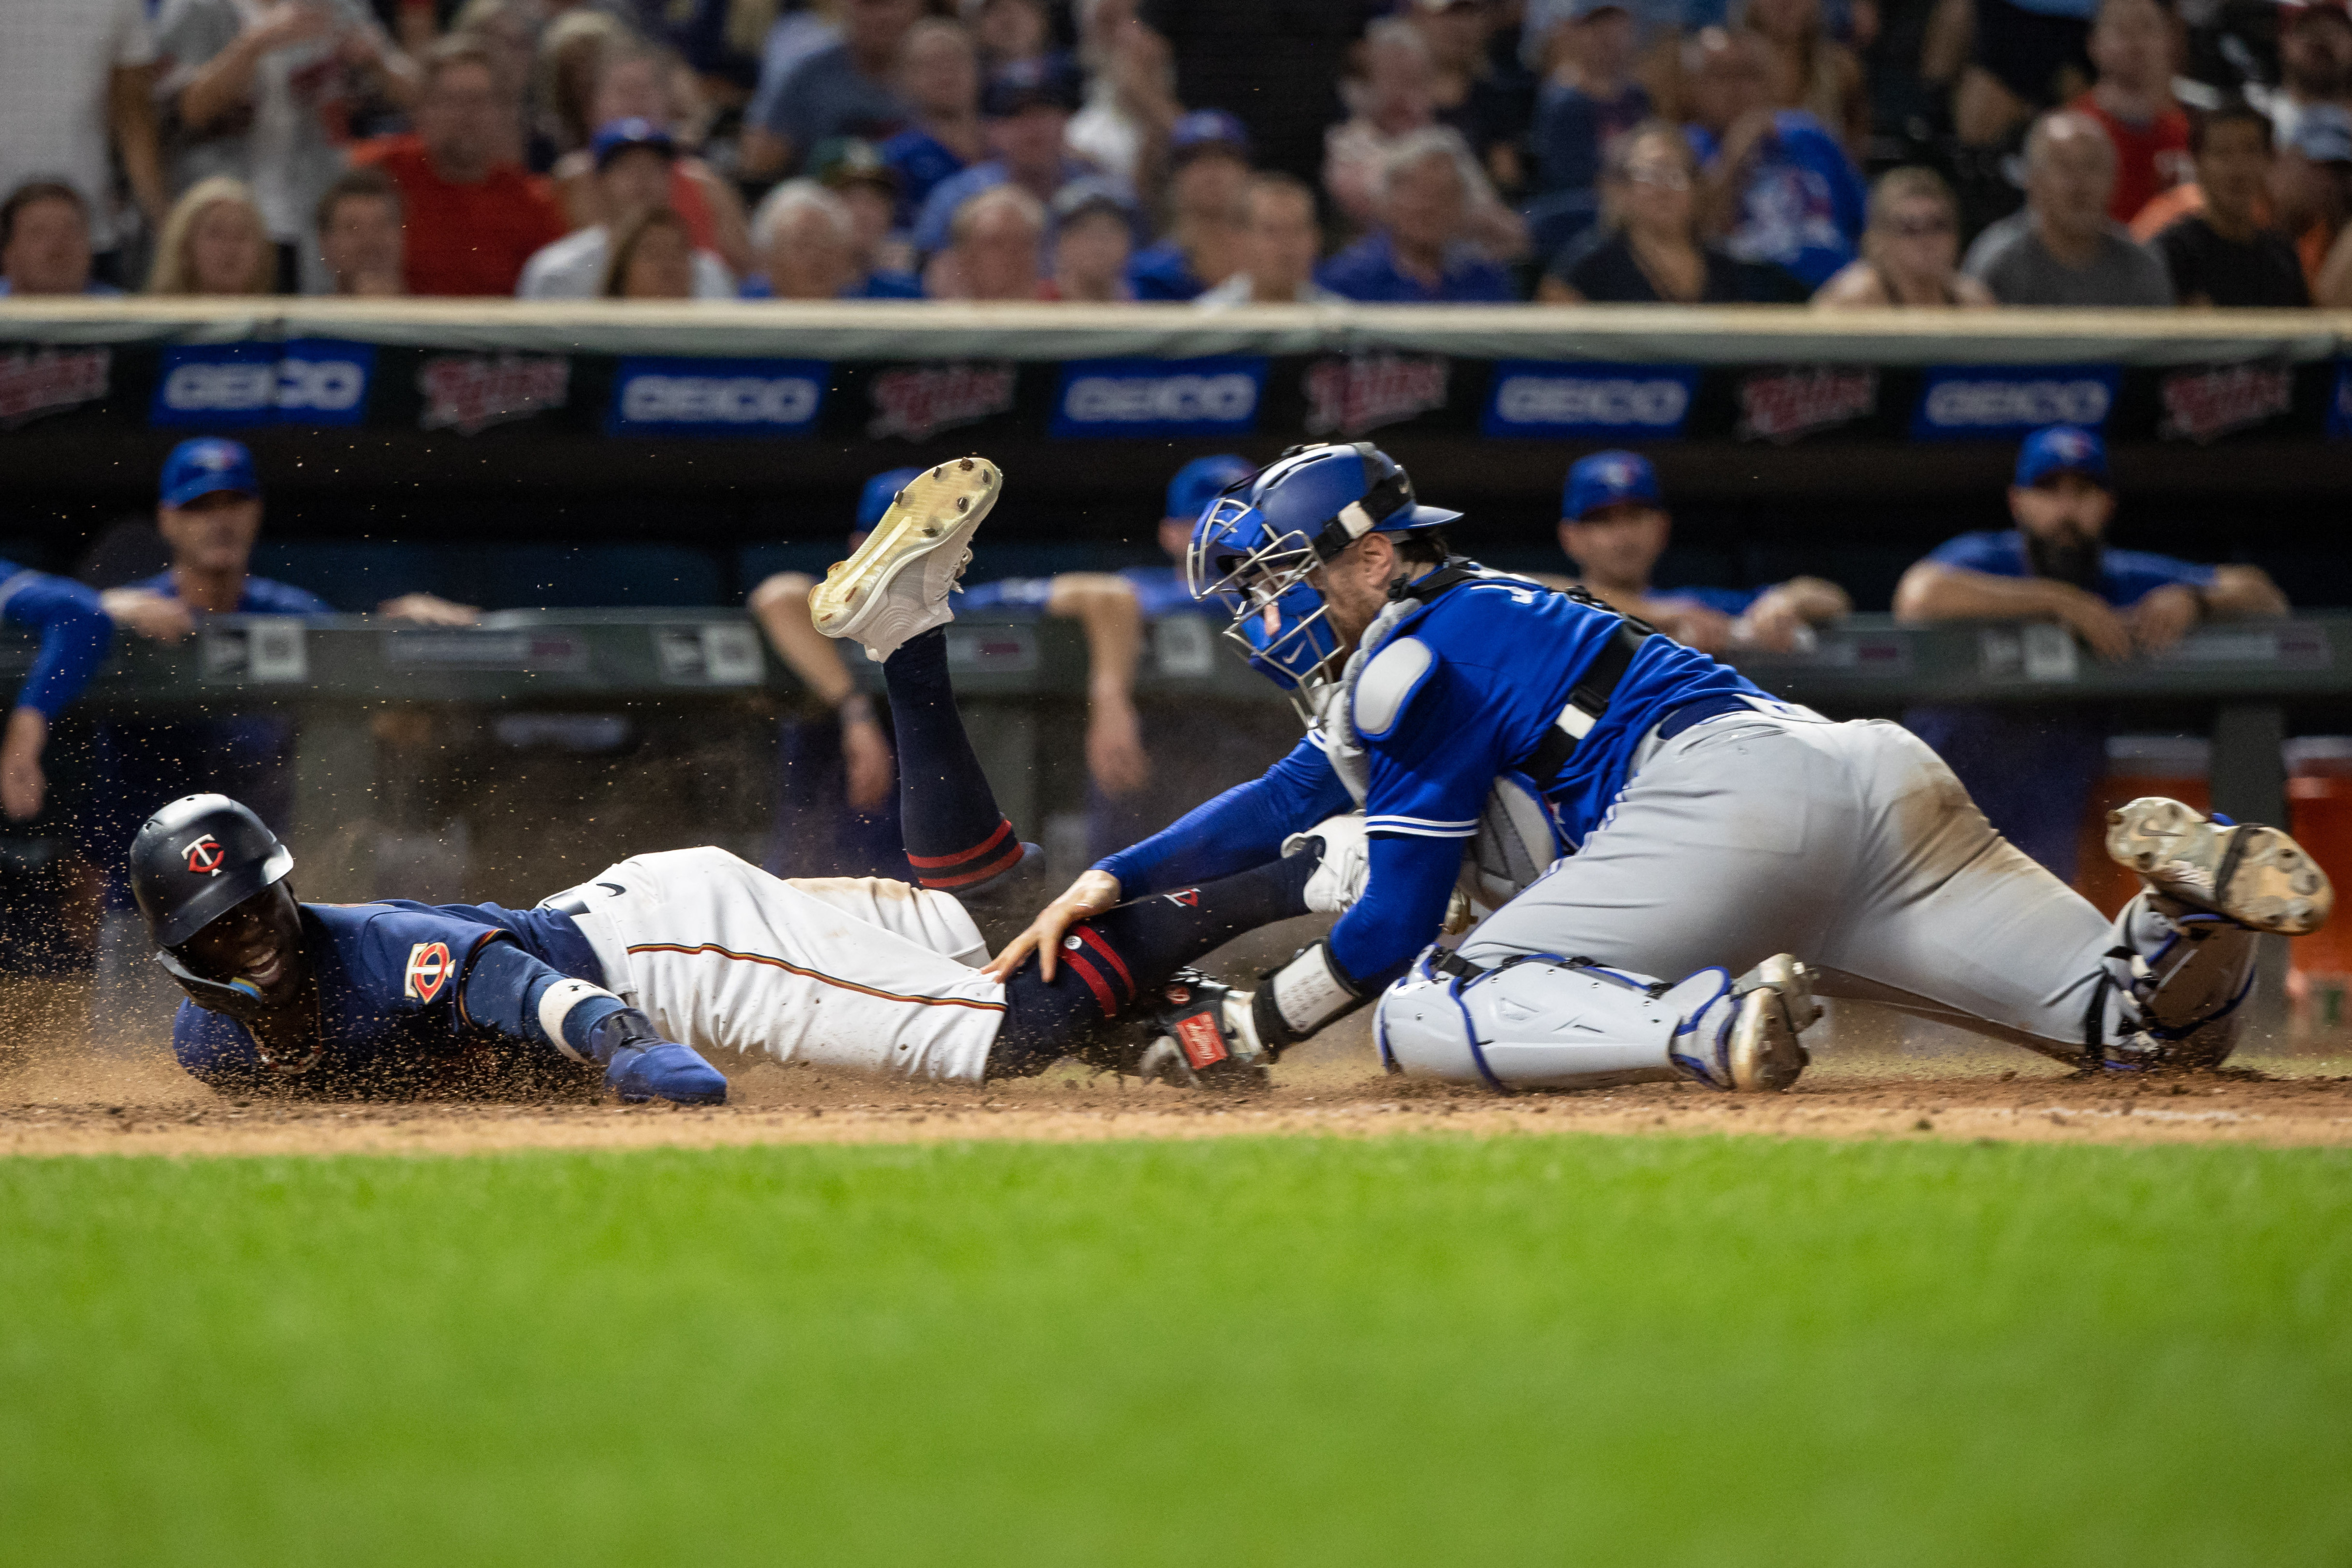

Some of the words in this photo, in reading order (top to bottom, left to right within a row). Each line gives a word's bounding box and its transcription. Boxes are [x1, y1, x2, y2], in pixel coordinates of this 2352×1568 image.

[163, 360, 365, 411] GEICO
[622, 374, 819, 423] GEICO
[1066, 372, 1256, 422] GEICO
[1495, 376, 1689, 425] GEICO
[1925, 381, 2112, 426] GEICO
